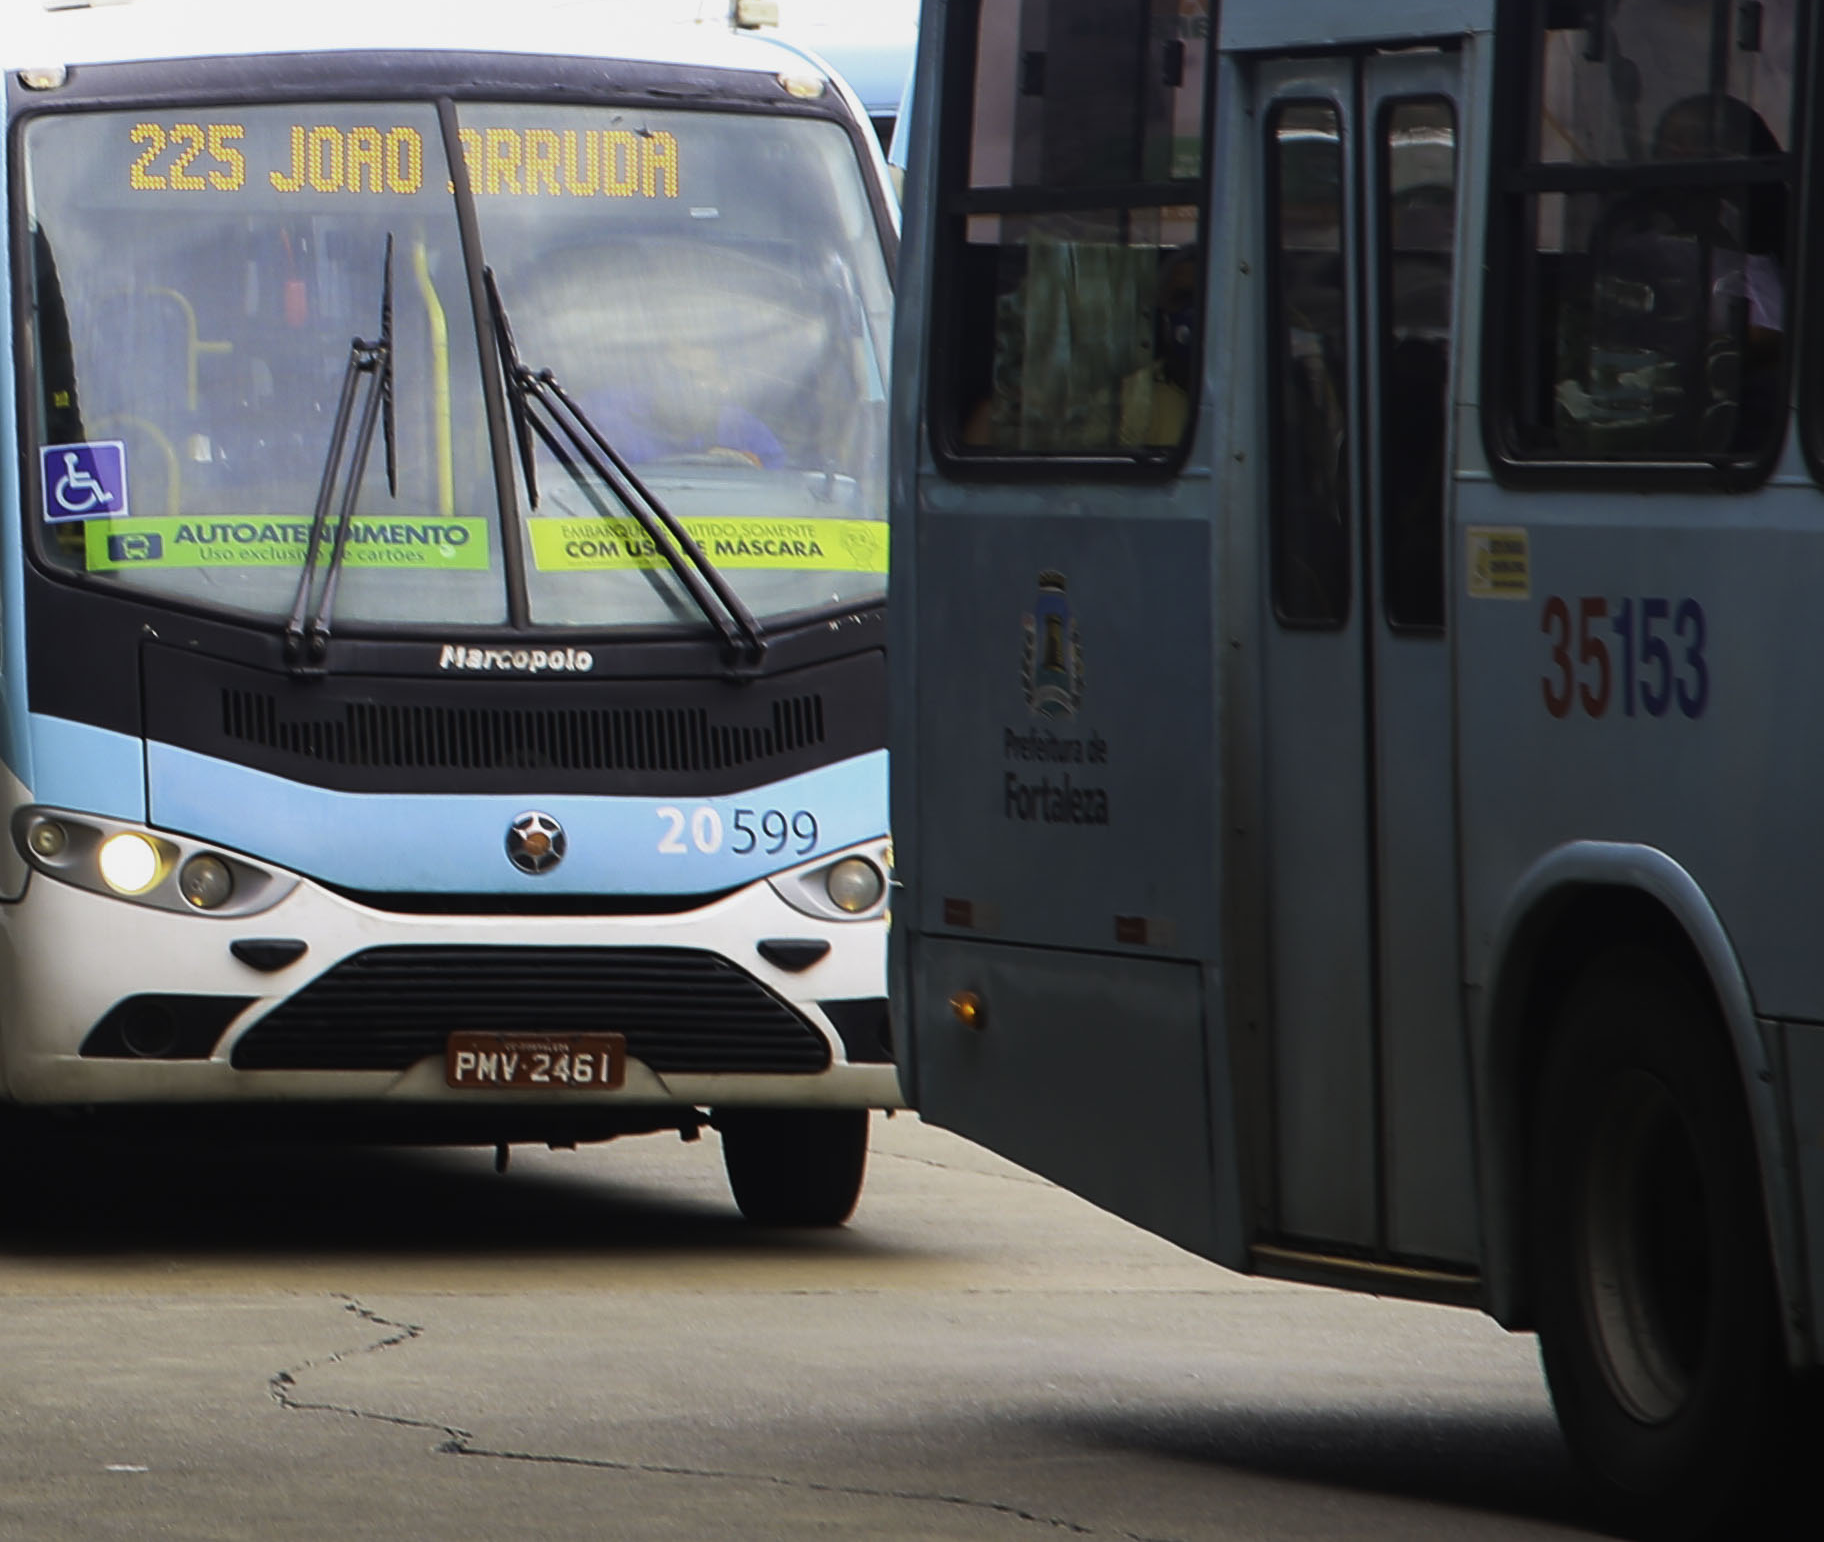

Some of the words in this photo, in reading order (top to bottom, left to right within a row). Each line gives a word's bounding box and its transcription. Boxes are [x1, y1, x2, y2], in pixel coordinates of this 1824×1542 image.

[129, 123, 245, 192] 225
[269, 125, 424, 195] JOAO
[565, 541, 620, 557] COM
[742, 524, 817, 539] SOMENTE
[199, 548, 233, 562] Uso
[356, 548, 425, 564] cartões
[440, 645, 594, 674] Marcopolo
[1541, 595, 1710, 720] 35153
[1004, 725, 1084, 763] Prefeitura
[1088, 726, 1108, 764] de
[1004, 770, 1110, 826] Fortaleza
[656, 805, 819, 856] 20599
